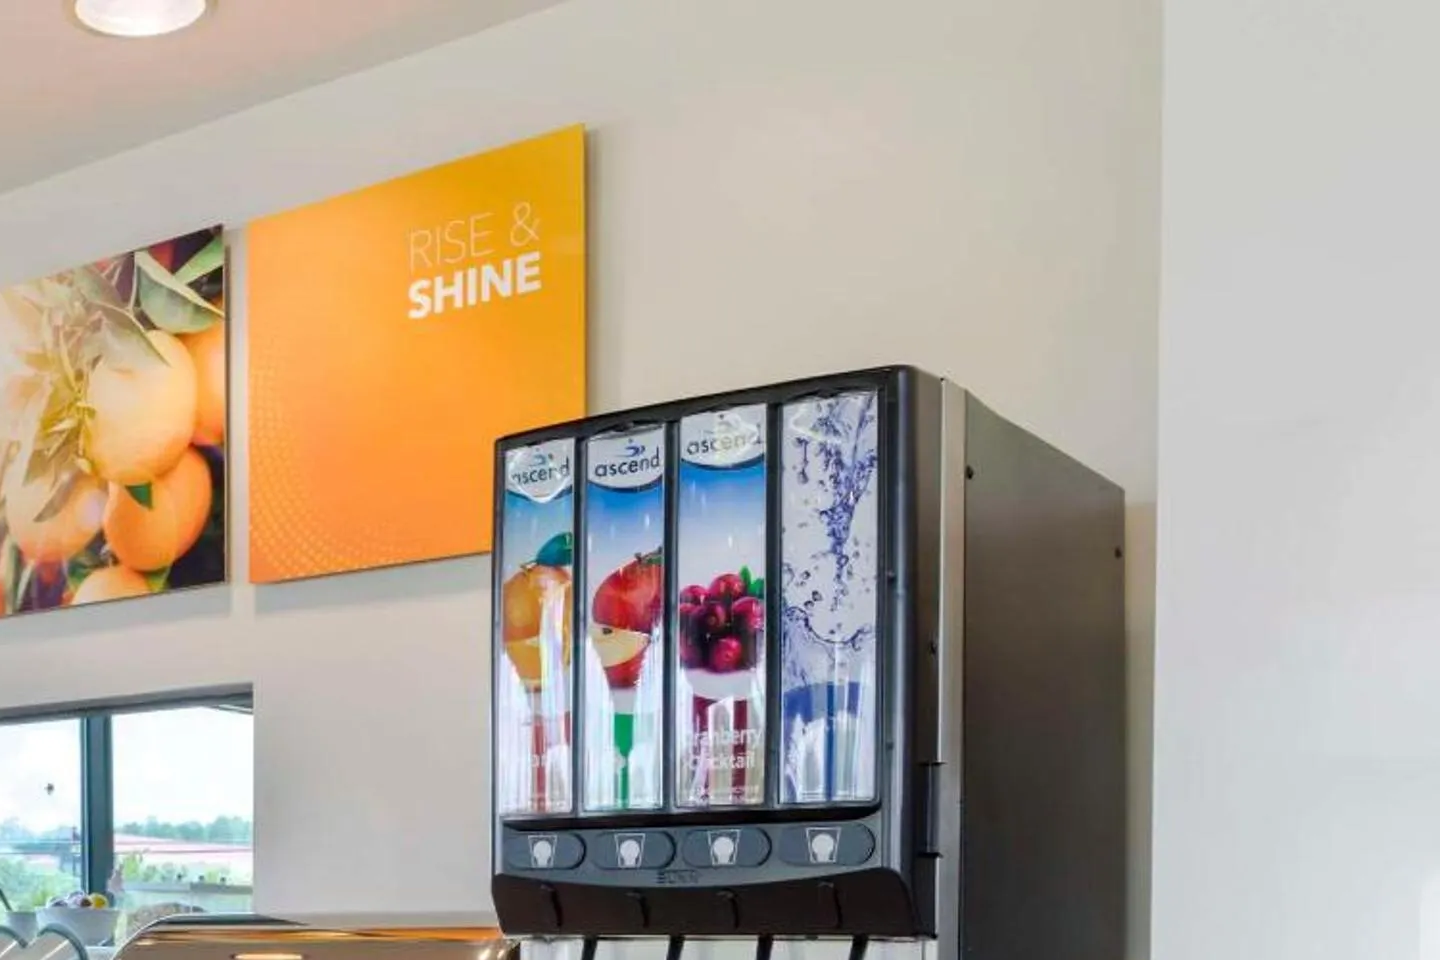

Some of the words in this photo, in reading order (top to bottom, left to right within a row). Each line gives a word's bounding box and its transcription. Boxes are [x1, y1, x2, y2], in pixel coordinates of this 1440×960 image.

[408, 212, 495, 273] RISE
[510, 201, 541, 247] &
[408, 251, 542, 319] SHINE
[594, 446, 660, 478] ascend
